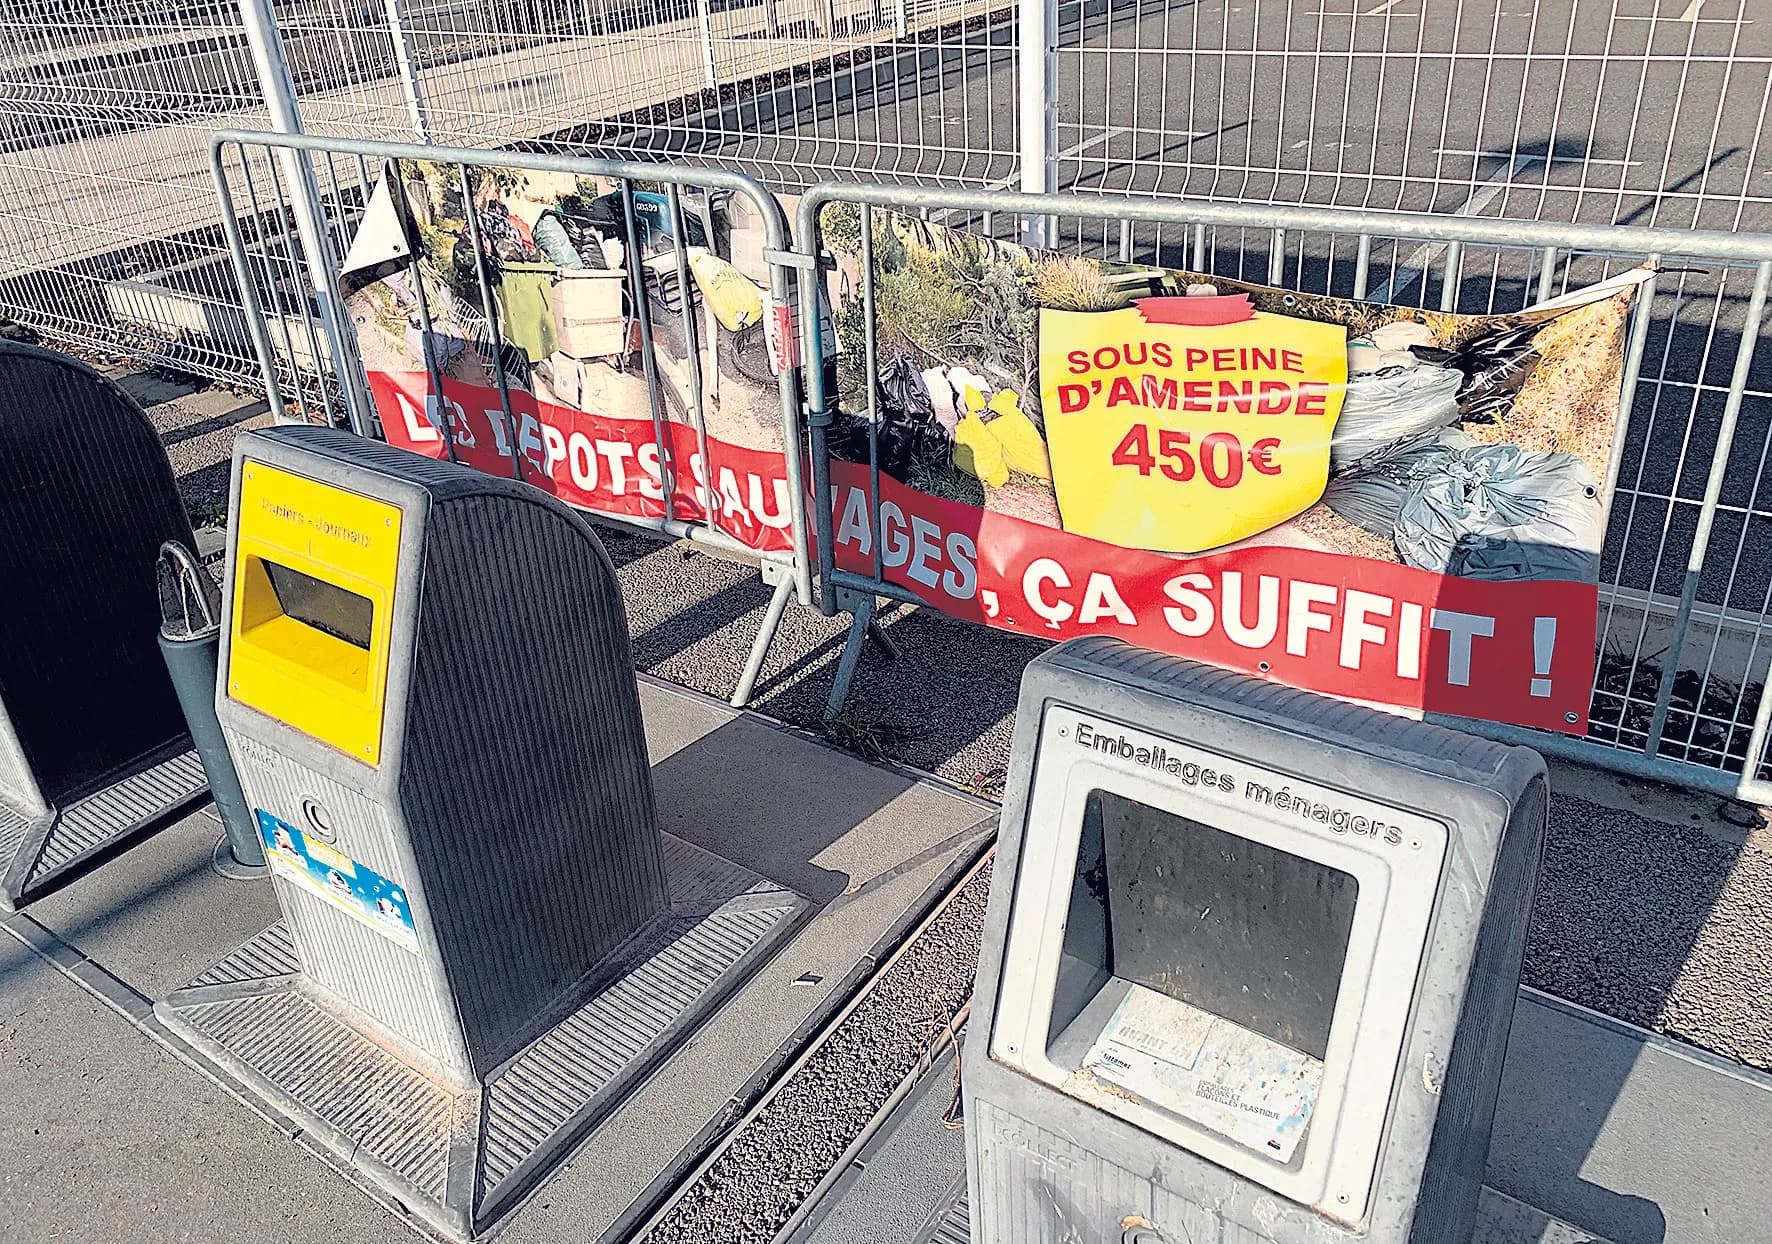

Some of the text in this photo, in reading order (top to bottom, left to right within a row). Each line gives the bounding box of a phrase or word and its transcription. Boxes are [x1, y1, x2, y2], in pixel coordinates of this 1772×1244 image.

[1067, 342, 1305, 375] SOUS PEINE
[1111, 423, 1282, 489] 450€
[1021, 557, 1138, 629] ÇA
[1162, 570, 1496, 687] SUFFIT
[1529, 616, 1558, 698] !
[1074, 721, 1404, 847] Emballages ménagers
[1239, 1102, 1280, 1121] PLASTIQUE
